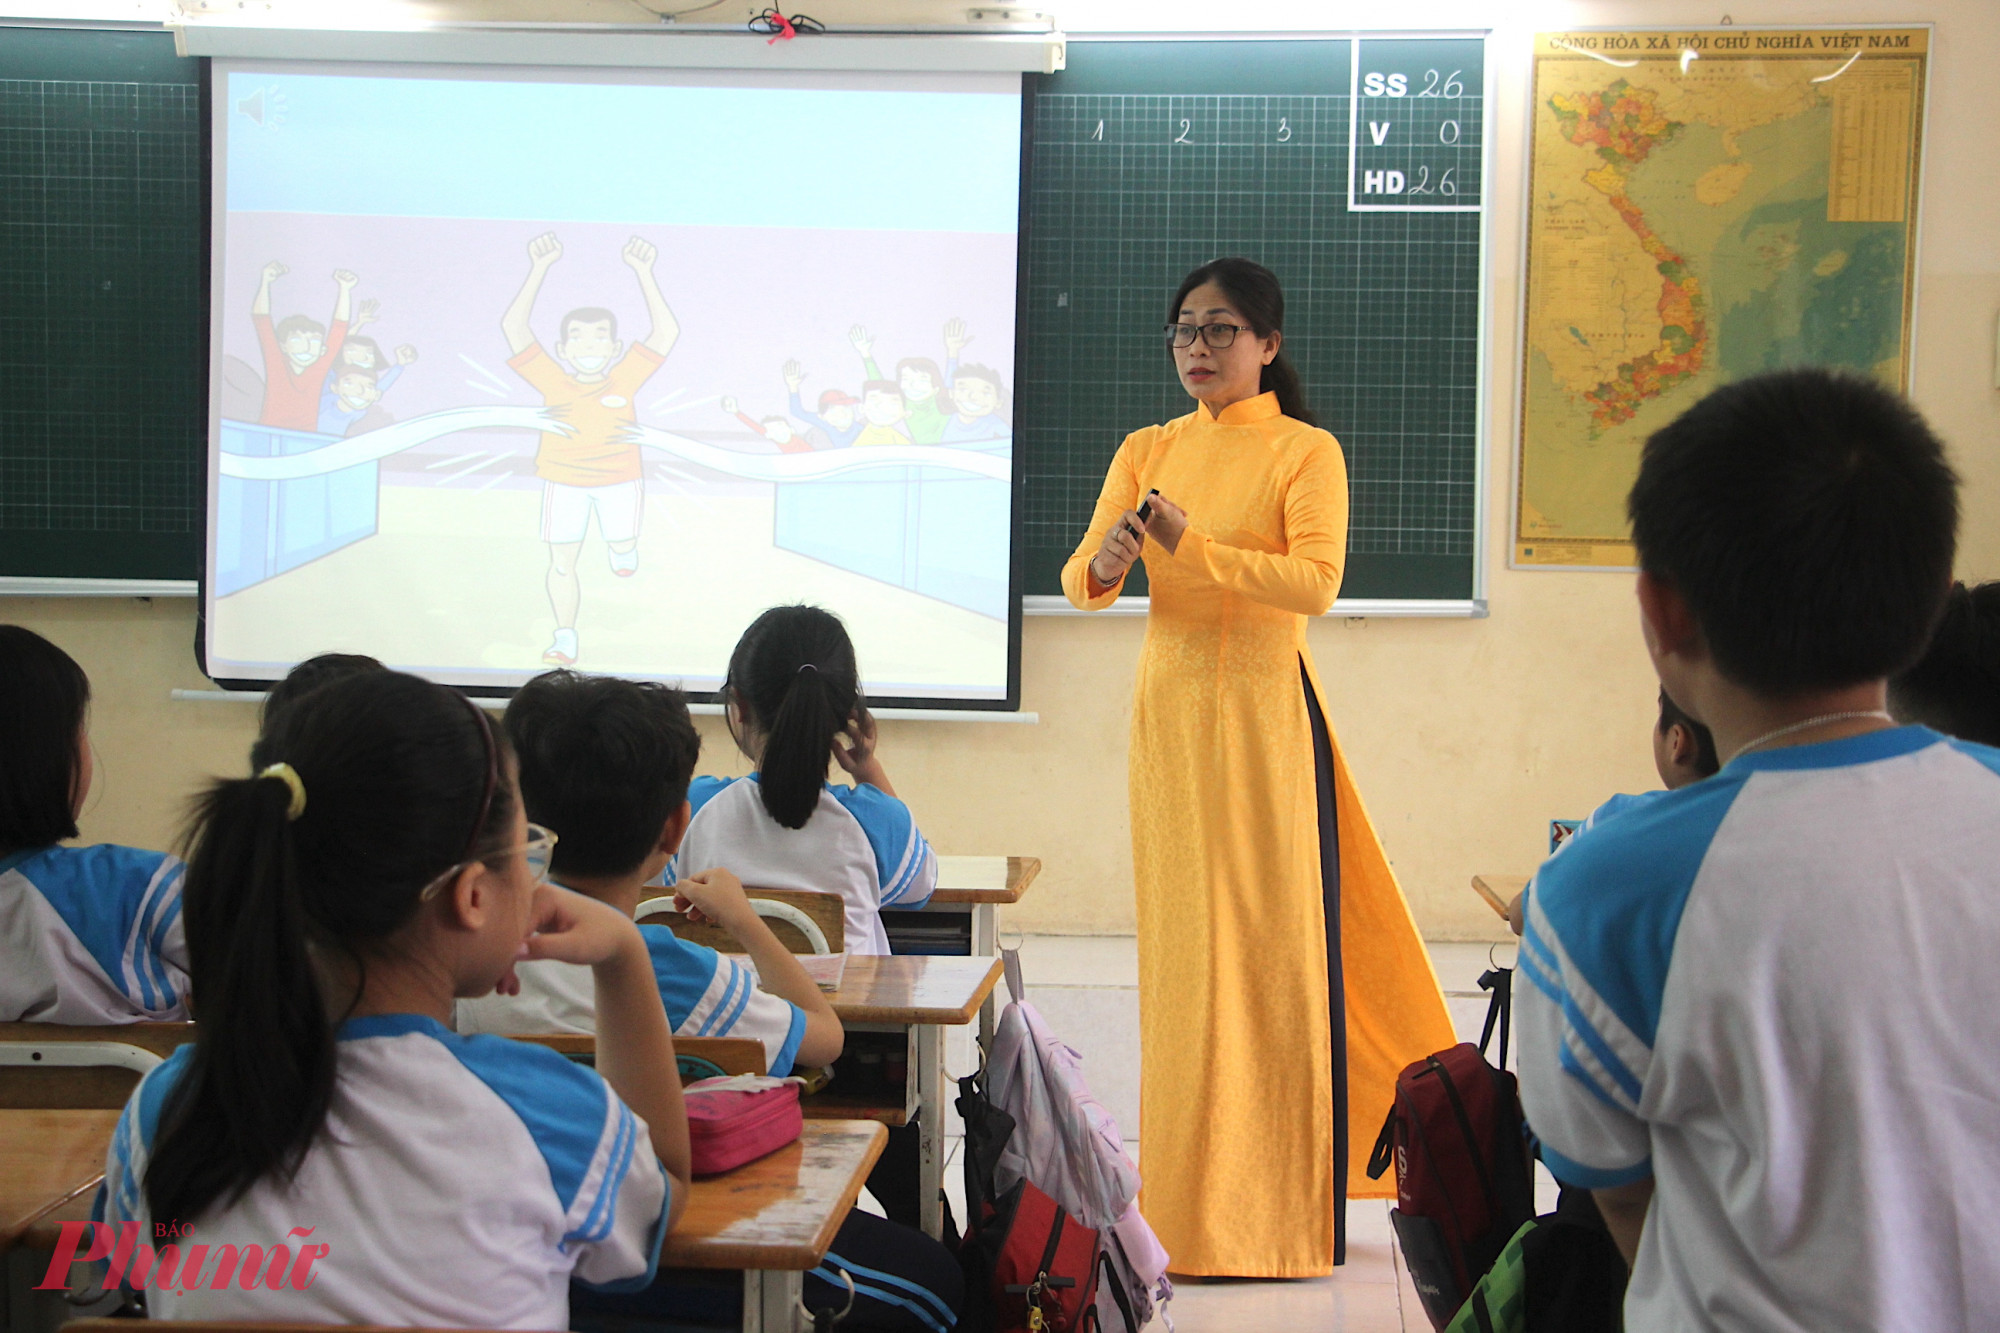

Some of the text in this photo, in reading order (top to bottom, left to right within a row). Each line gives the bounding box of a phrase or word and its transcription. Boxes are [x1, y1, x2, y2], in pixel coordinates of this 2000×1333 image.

[1549, 34, 1598, 51] CỘNG
[1603, 33, 1640, 50] HÒA
[1645, 34, 1671, 49] XÃ
[1714, 31, 1749, 49] CHỦ
[1756, 32, 1814, 49] NGHĨA
[1820, 32, 1863, 51] VIỆT
[1868, 35, 1910, 48] NAM
[1363, 68, 1463, 99] SS 26
[1091, 117, 1292, 144] 1 2 3
[1369, 119, 1460, 146] V 0
[1363, 165, 1456, 196] HD 26
